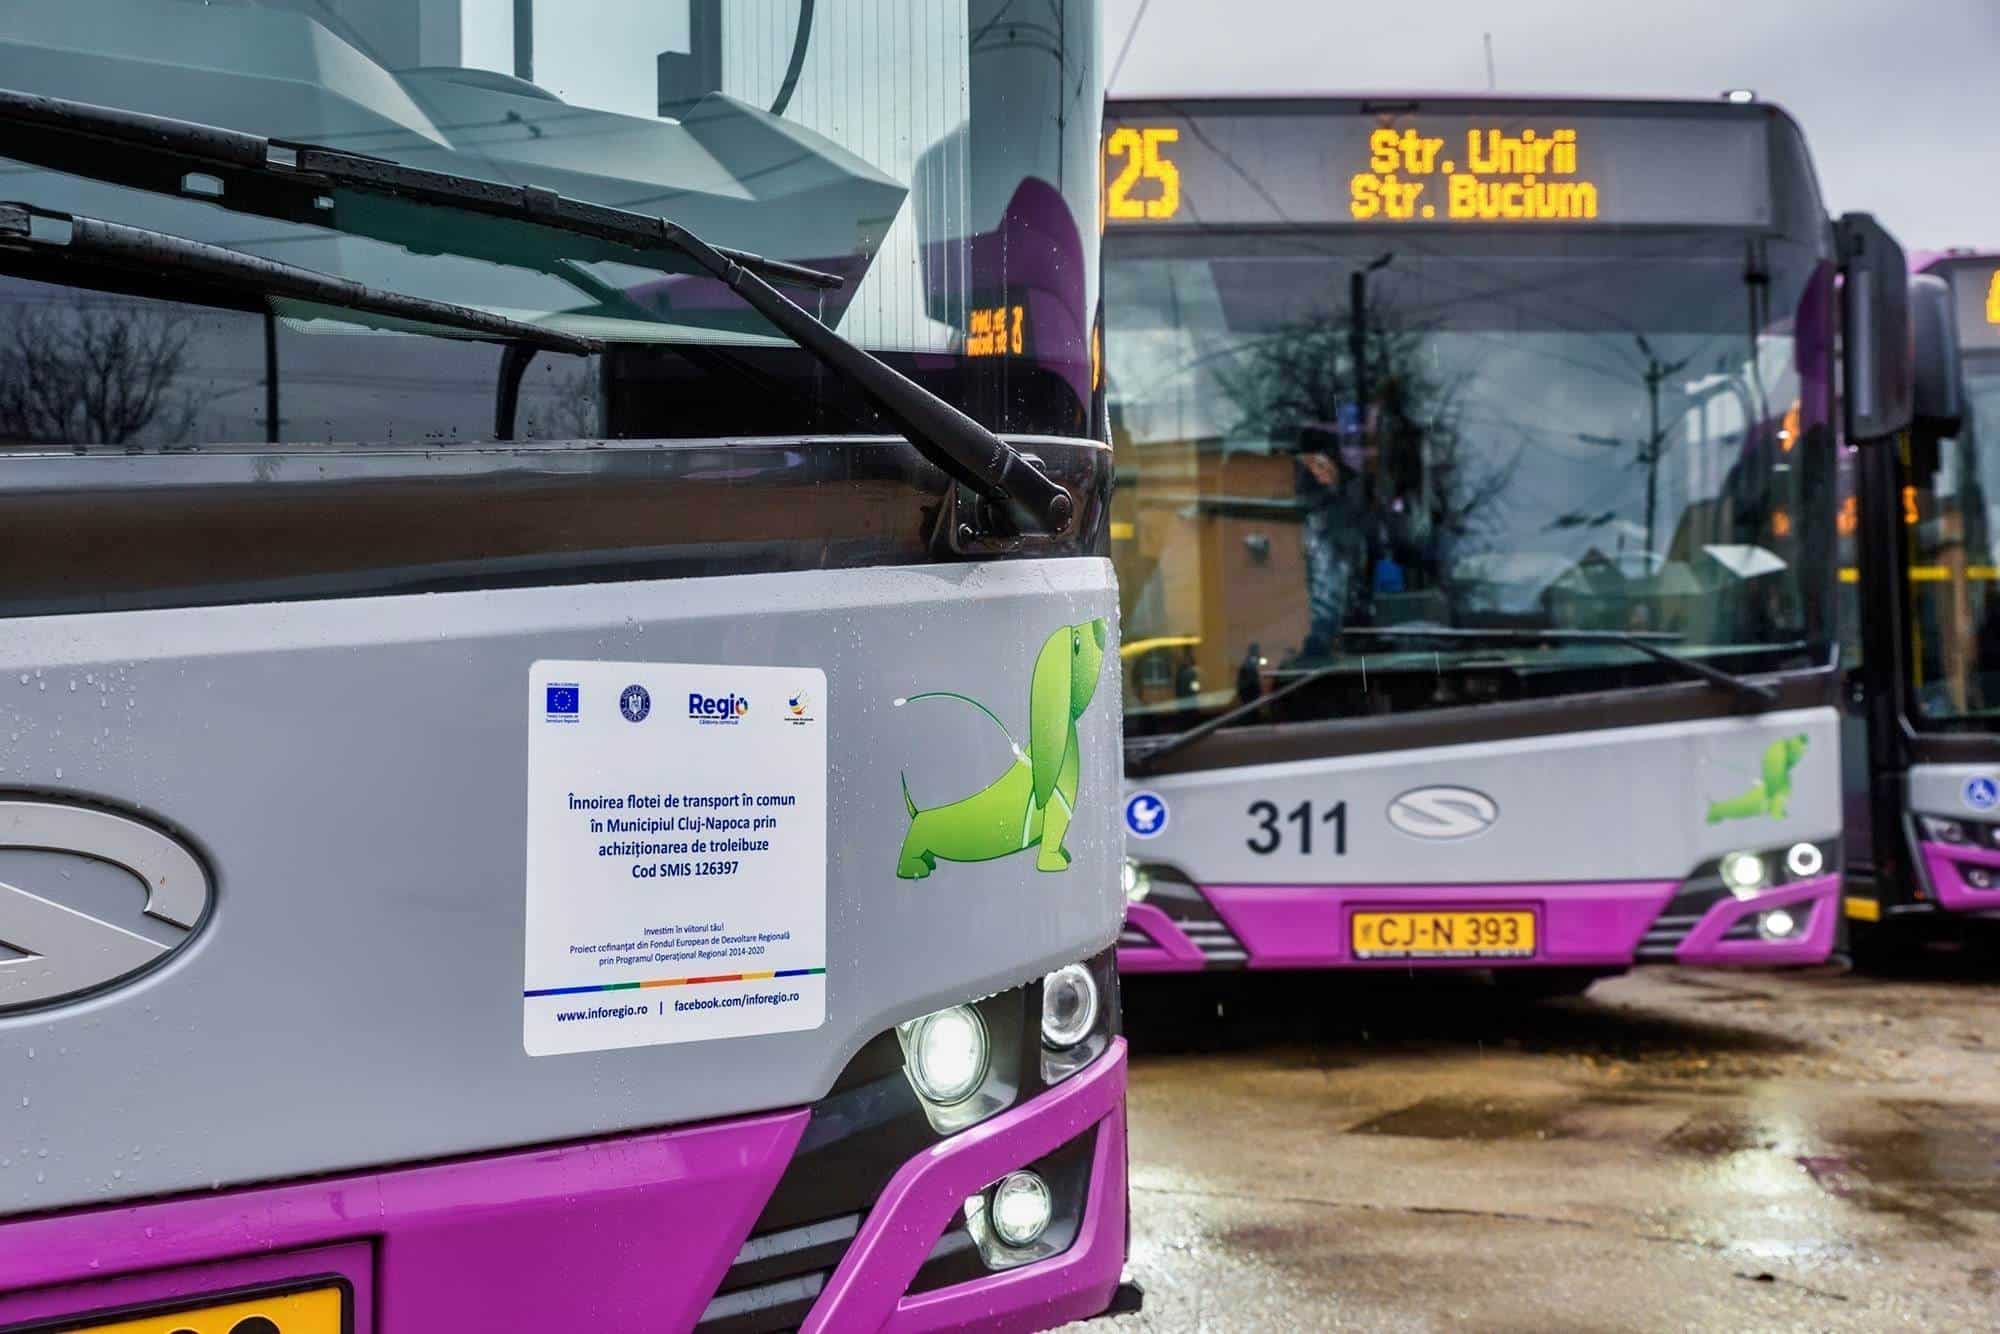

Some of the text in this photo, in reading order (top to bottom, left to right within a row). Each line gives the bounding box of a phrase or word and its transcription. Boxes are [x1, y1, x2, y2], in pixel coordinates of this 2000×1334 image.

[1371, 129, 1577, 175] Str. Unirii
[1108, 128, 1179, 218] 25
[1350, 175, 1598, 219] Str. Bucium
[689, 693, 749, 720] Regio
[568, 792, 796, 810] Înnoirea flotei de transport în comun
[590, 815, 777, 834] în Municipiul Cluj-Napoca prin
[1247, 801, 1347, 855] 311
[598, 838, 769, 858] achiziționarea de troleibuze
[632, 861, 739, 878] Cod SMIS 126397
[644, 925, 675, 936] Investim
[1378, 918, 1520, 947] CJ-N 393
[569, 944, 596, 954] Proiect
[636, 942, 648, 950] din
[650, 939, 674, 949] Fondul
[676, 938, 709, 947] European
[710, 936, 720, 945] de
[721, 934, 757, 944] Dezvoltare
[599, 957, 614, 967] prin
[615, 953, 653, 966] Programul
[698, 949, 727, 960] Regional
[729, 946, 765, 957] 2014-2020
[557, 992, 800, 1022] www.inforegio.ro facebook.com/inforegio.ro
